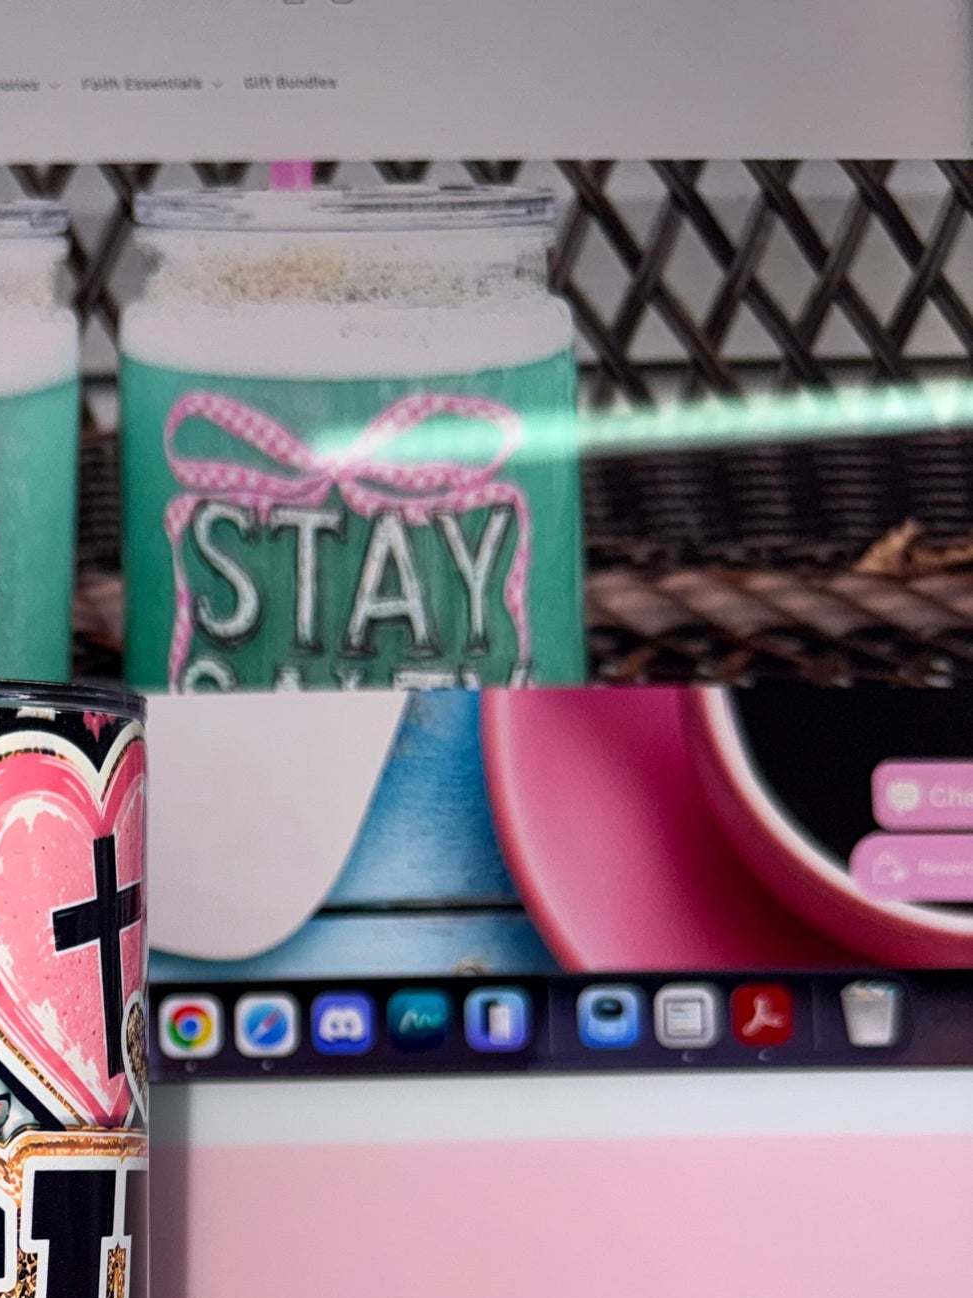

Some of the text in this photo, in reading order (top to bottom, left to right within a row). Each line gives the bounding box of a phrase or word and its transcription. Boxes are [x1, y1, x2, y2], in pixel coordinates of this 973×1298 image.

[80, 76, 202, 91] Faith Essentials
[243, 74, 337, 90] Gift Bundles
[193, 502, 514, 658] STAY
